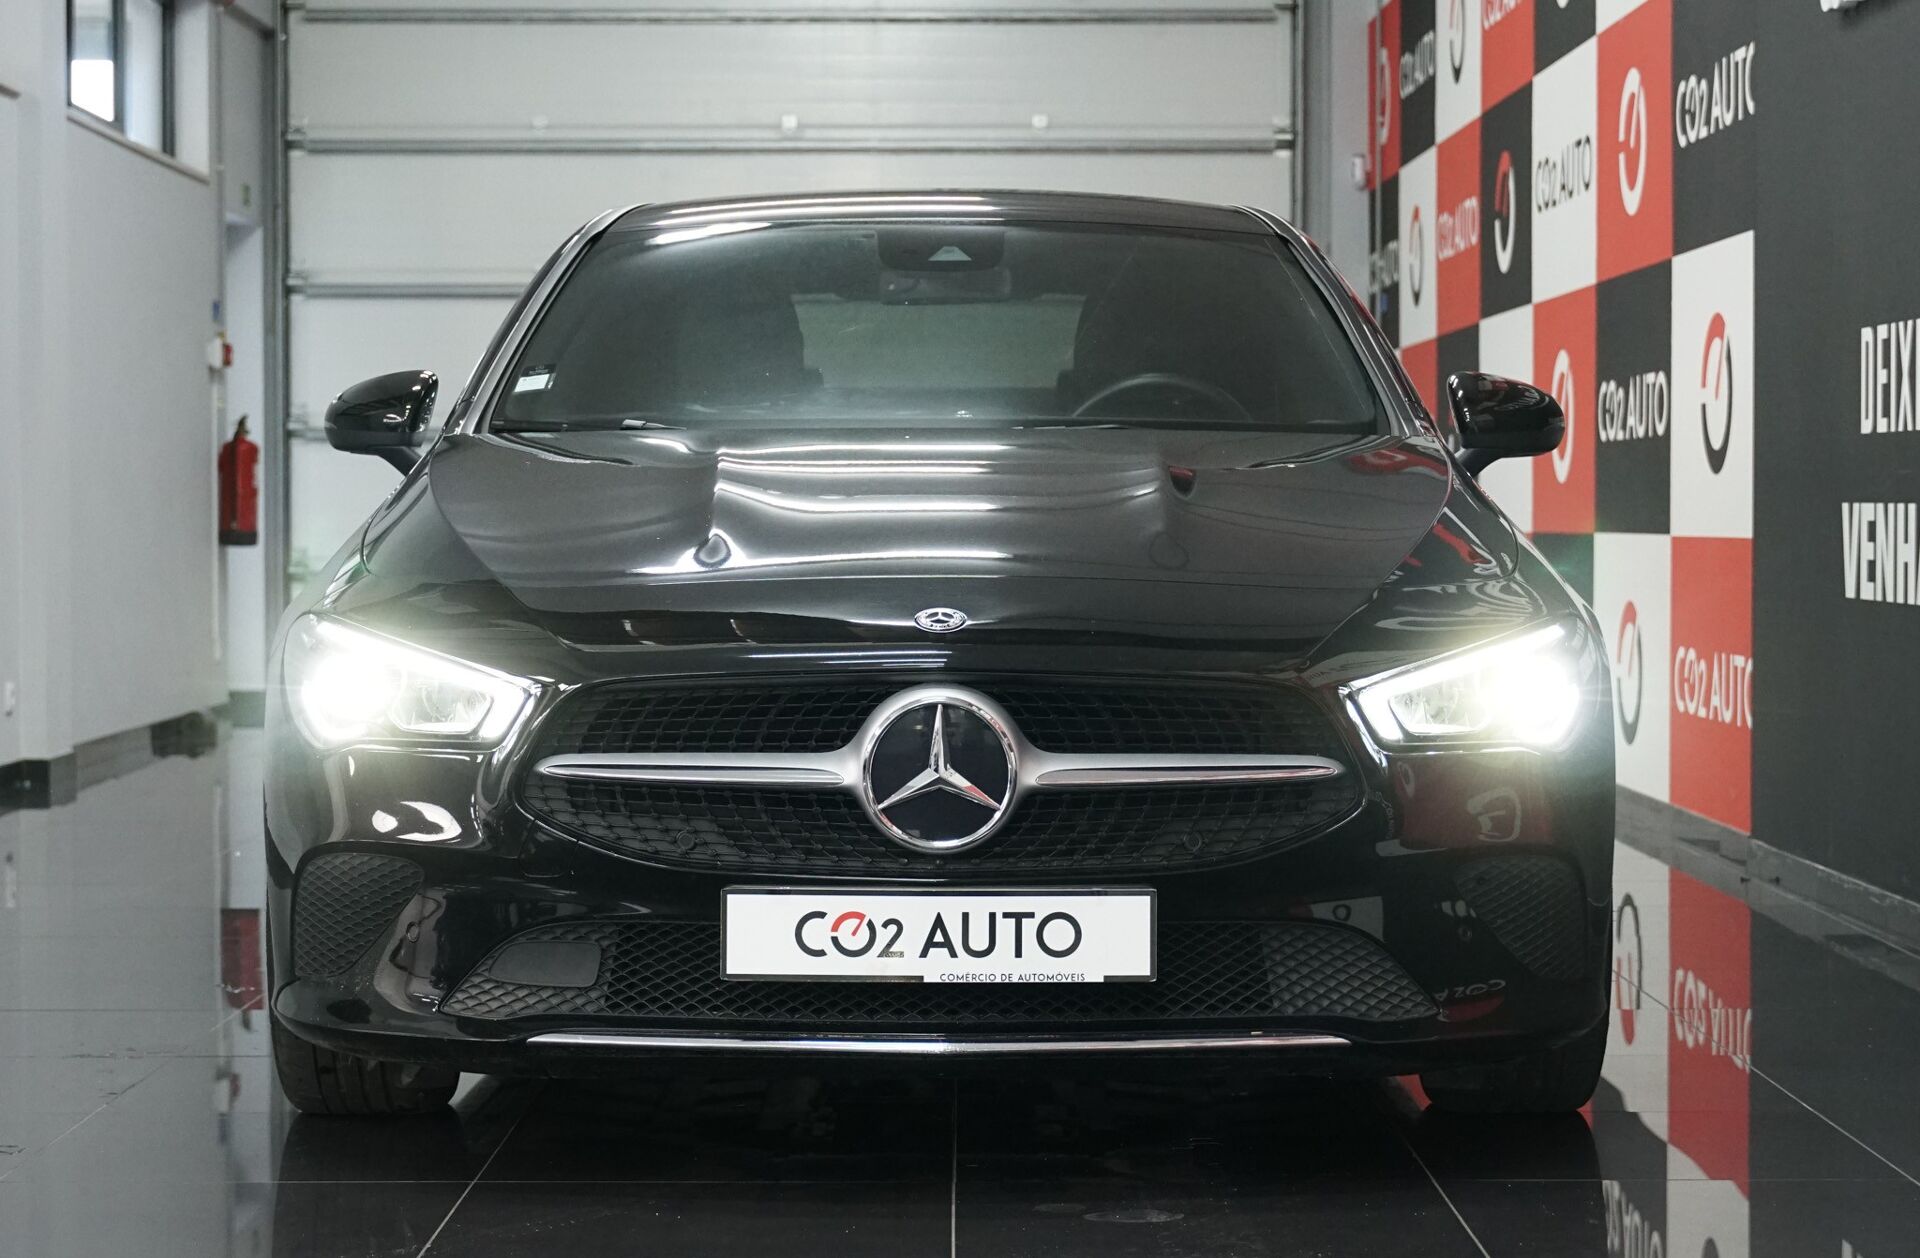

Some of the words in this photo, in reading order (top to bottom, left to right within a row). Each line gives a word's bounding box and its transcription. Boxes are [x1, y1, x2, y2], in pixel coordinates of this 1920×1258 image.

[1414, 30, 1435, 88] AUTO
[1676, 74, 1709, 148] CO2
[1535, 156, 1557, 213] CO2
[1558, 134, 1592, 205] AUTO
[1455, 196, 1480, 252] AUTO
[1598, 379, 1626, 443] CO2
[1625, 370, 1669, 440] AUTO
[1674, 645, 1707, 718] CO2
[794, 910, 904, 958] CO2
[918, 911, 1083, 959] AUTO
[939, 972, 998, 982] COMÉRCIO
[1000, 973, 1014, 982] DE
[1017, 972, 1086, 982] AUTOMÓVEIS
